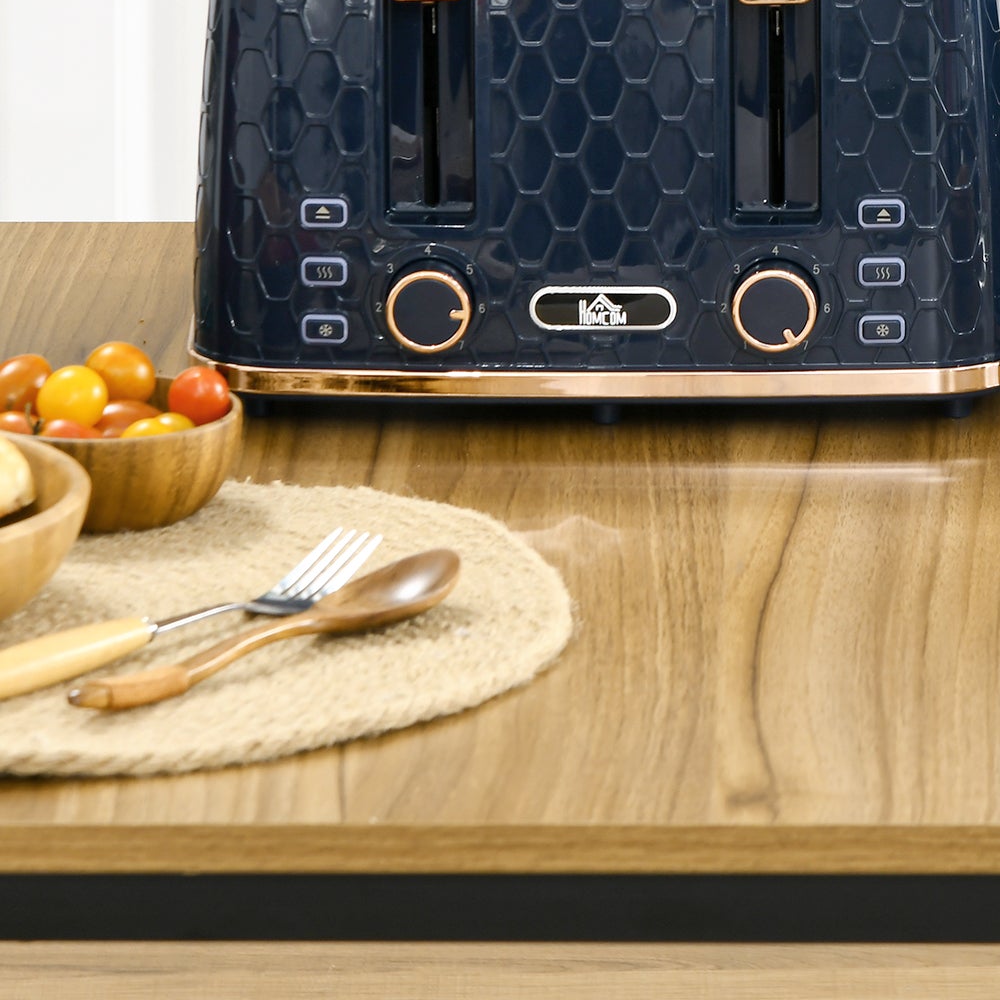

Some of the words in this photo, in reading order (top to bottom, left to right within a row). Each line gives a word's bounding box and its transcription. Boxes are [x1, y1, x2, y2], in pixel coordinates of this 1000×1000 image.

[423, 245, 432, 256] 4
[771, 245, 779, 256] 4
[386, 263, 394, 274] 3
[466, 264, 474, 275] 5
[733, 264, 741, 274] 3
[813, 264, 820, 275] 5
[375, 302, 383, 313] 2
[478, 303, 486, 314] 6
[720, 303, 728, 313] 2
[823, 303, 831, 314] 6
